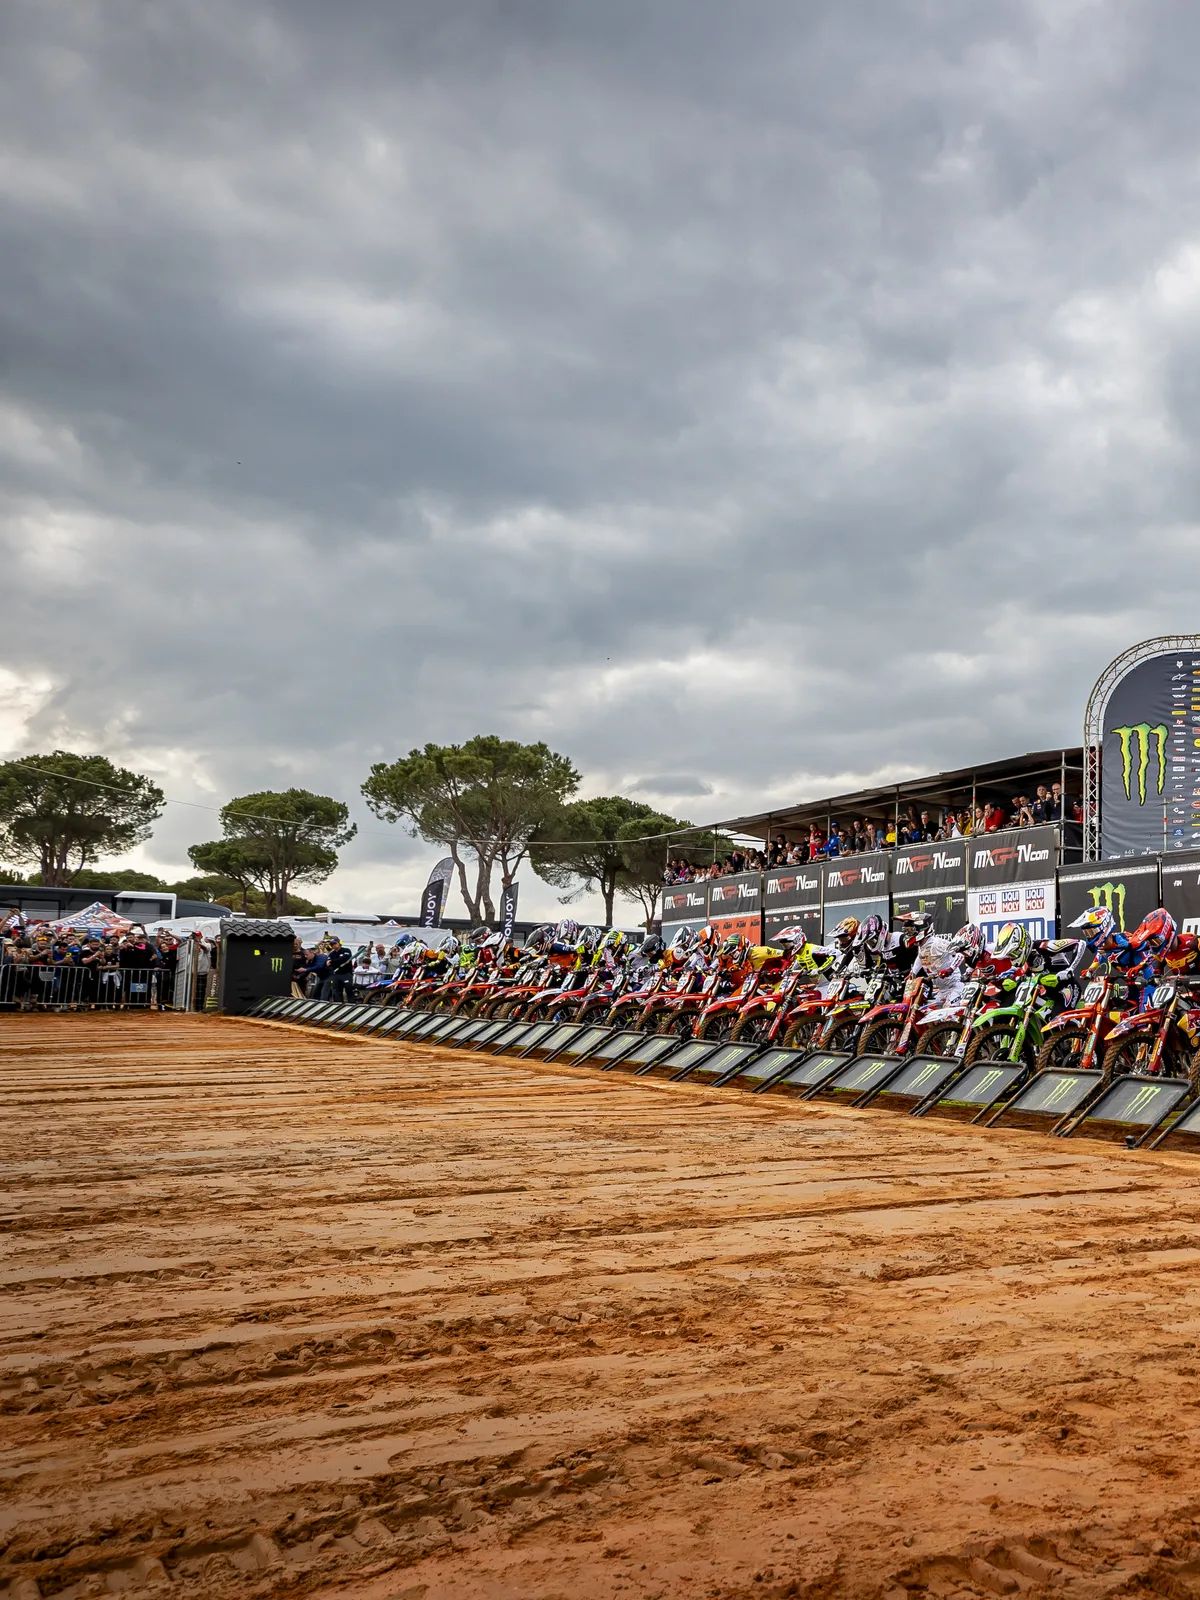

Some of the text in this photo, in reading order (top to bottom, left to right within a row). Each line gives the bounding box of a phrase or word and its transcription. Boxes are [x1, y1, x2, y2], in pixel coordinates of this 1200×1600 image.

[979, 893, 996, 904] LIQUI
[1002, 890, 1019, 901] LIQUI
[1025, 888, 1044, 899] LIQUI
[979, 904, 996, 914] MOLY
[1002, 901, 1019, 912] MOLY
[1026, 899, 1044, 910] MOLY
